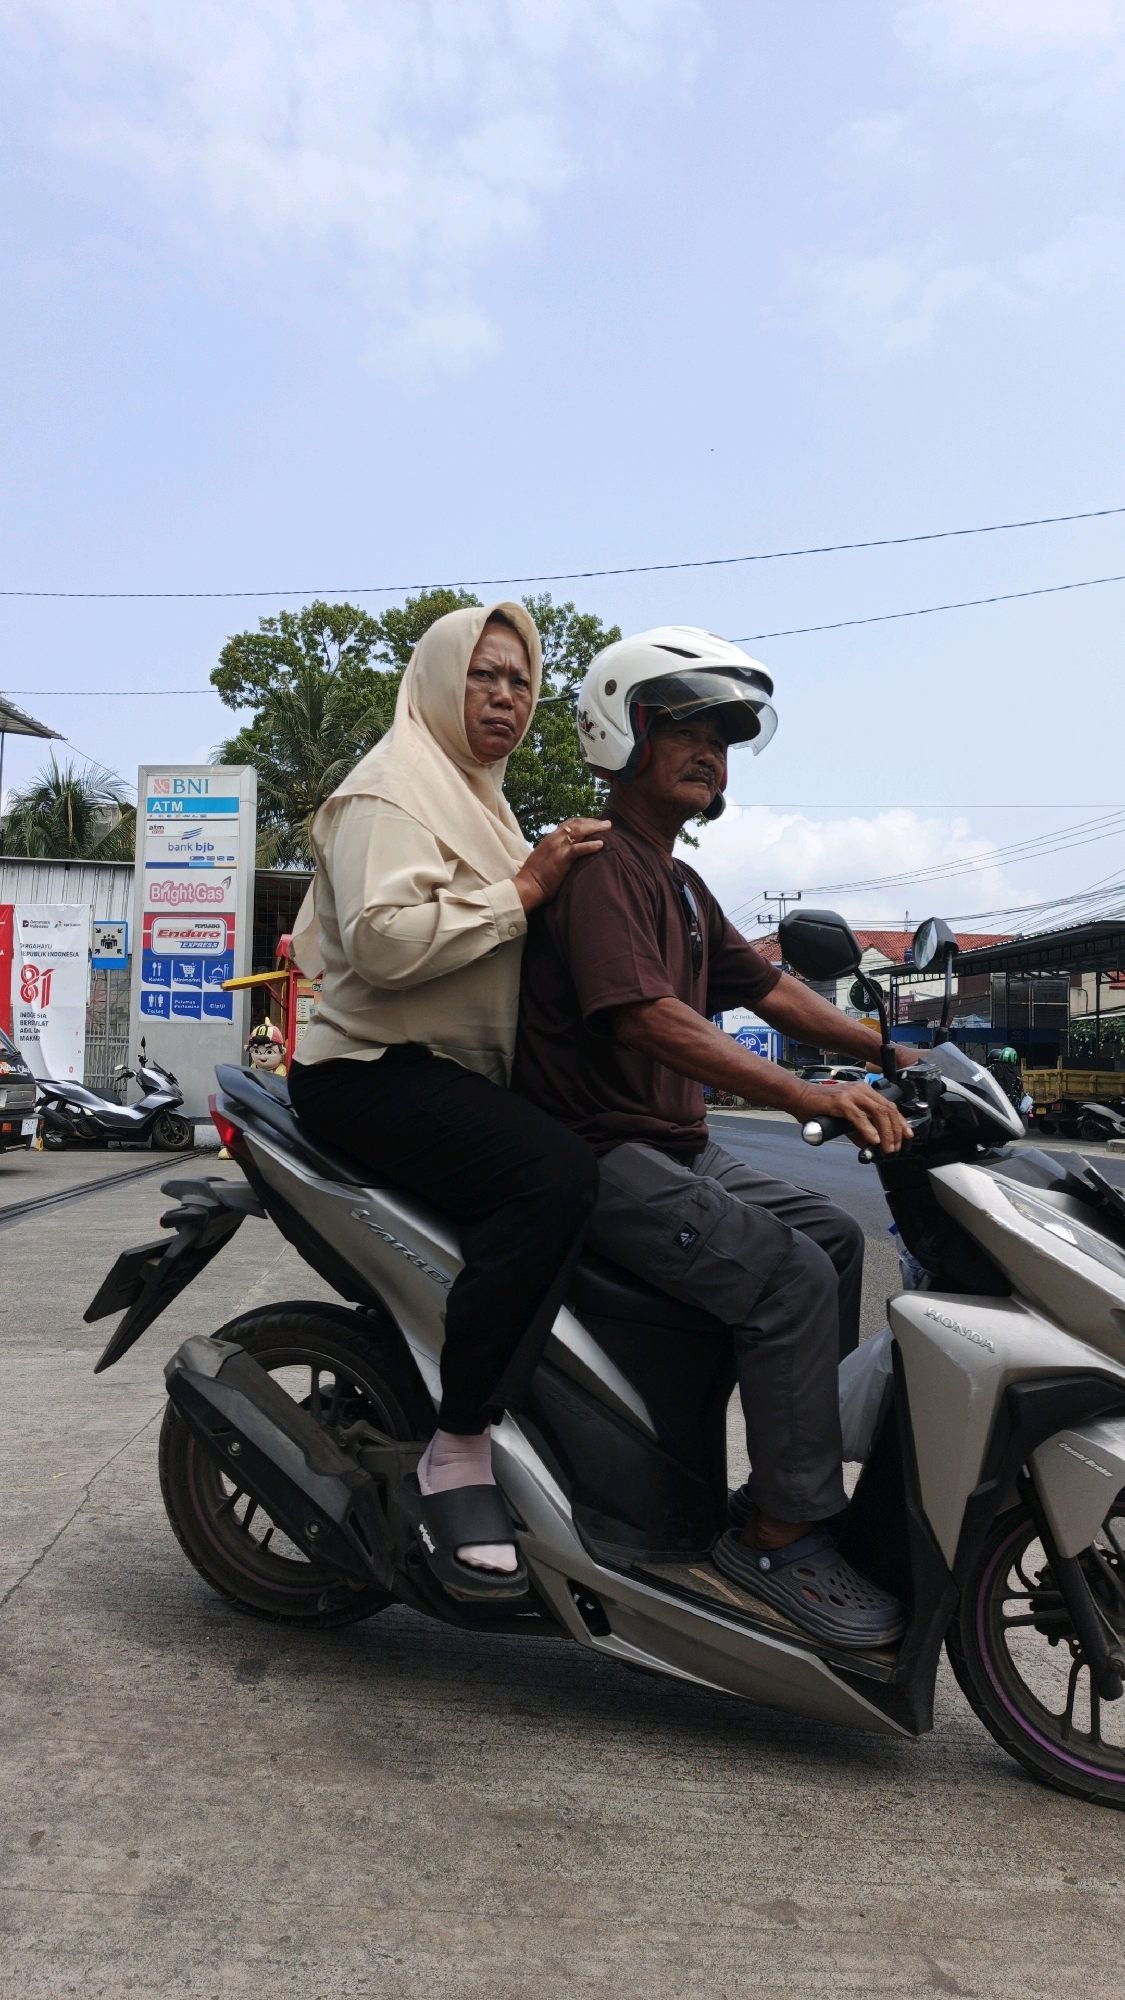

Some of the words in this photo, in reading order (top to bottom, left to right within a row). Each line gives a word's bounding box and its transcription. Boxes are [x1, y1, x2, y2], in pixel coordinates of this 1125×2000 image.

[173, 779, 209, 794] BNI
[152, 801, 183, 812] ATM
[167, 842, 193, 852] bank
[195, 842, 215, 853] bjb
[150, 881, 194, 906] Bright
[195, 883, 224, 903] Gas
[156, 929, 221, 938] Enduro
[20, 964, 55, 1010] 81
[924, 1307, 995, 1353] HONDA
[1084, 1459, 1113, 1477] Brake
